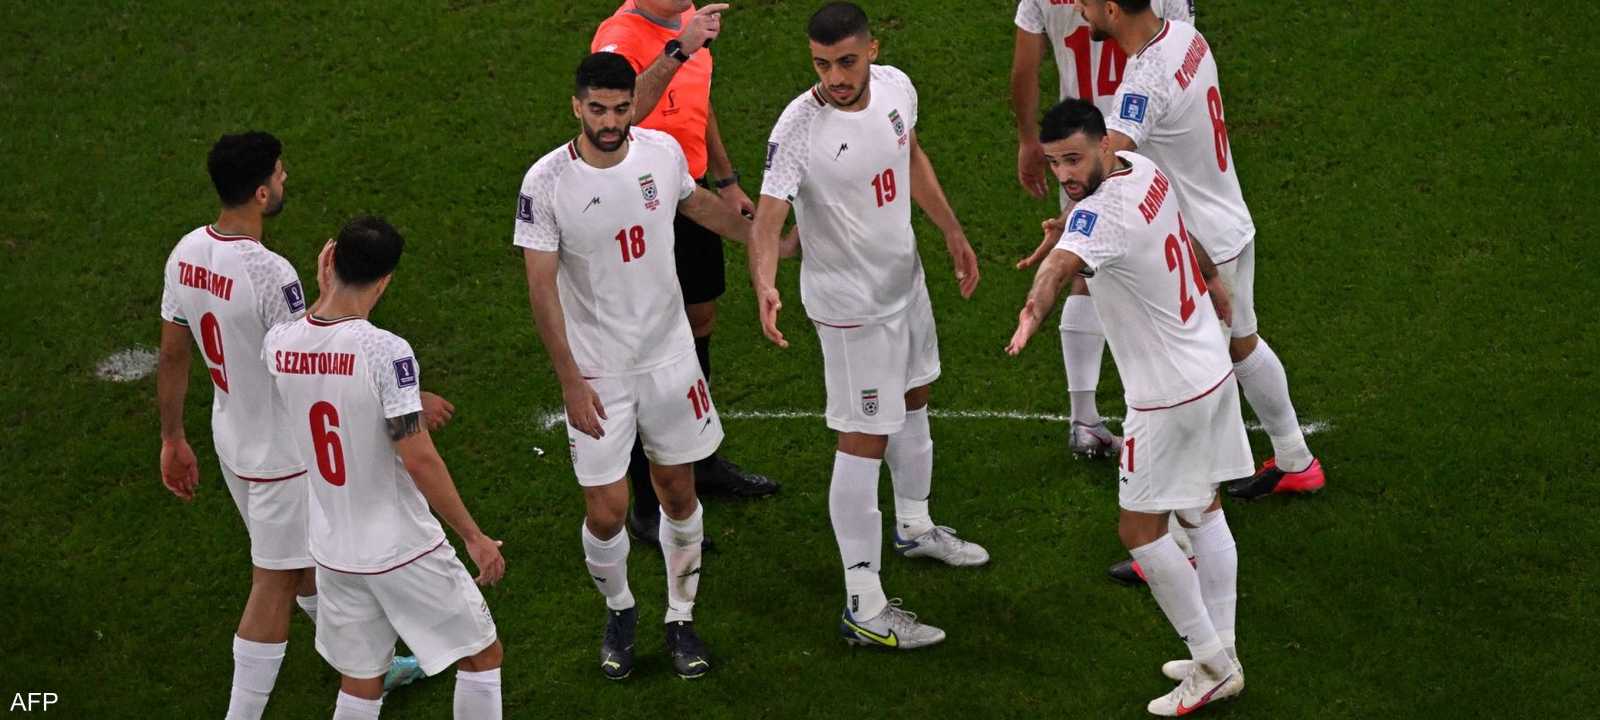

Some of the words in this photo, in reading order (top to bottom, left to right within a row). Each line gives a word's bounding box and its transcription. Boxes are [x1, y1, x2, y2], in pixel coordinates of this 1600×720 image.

[1207, 86, 1228, 173] 8
[871, 168, 897, 208] 19
[615, 224, 646, 263] 18
[1164, 211, 1208, 324] 21
[200, 311, 229, 394] 9
[687, 378, 709, 420] 18
[309, 400, 346, 487] 6
